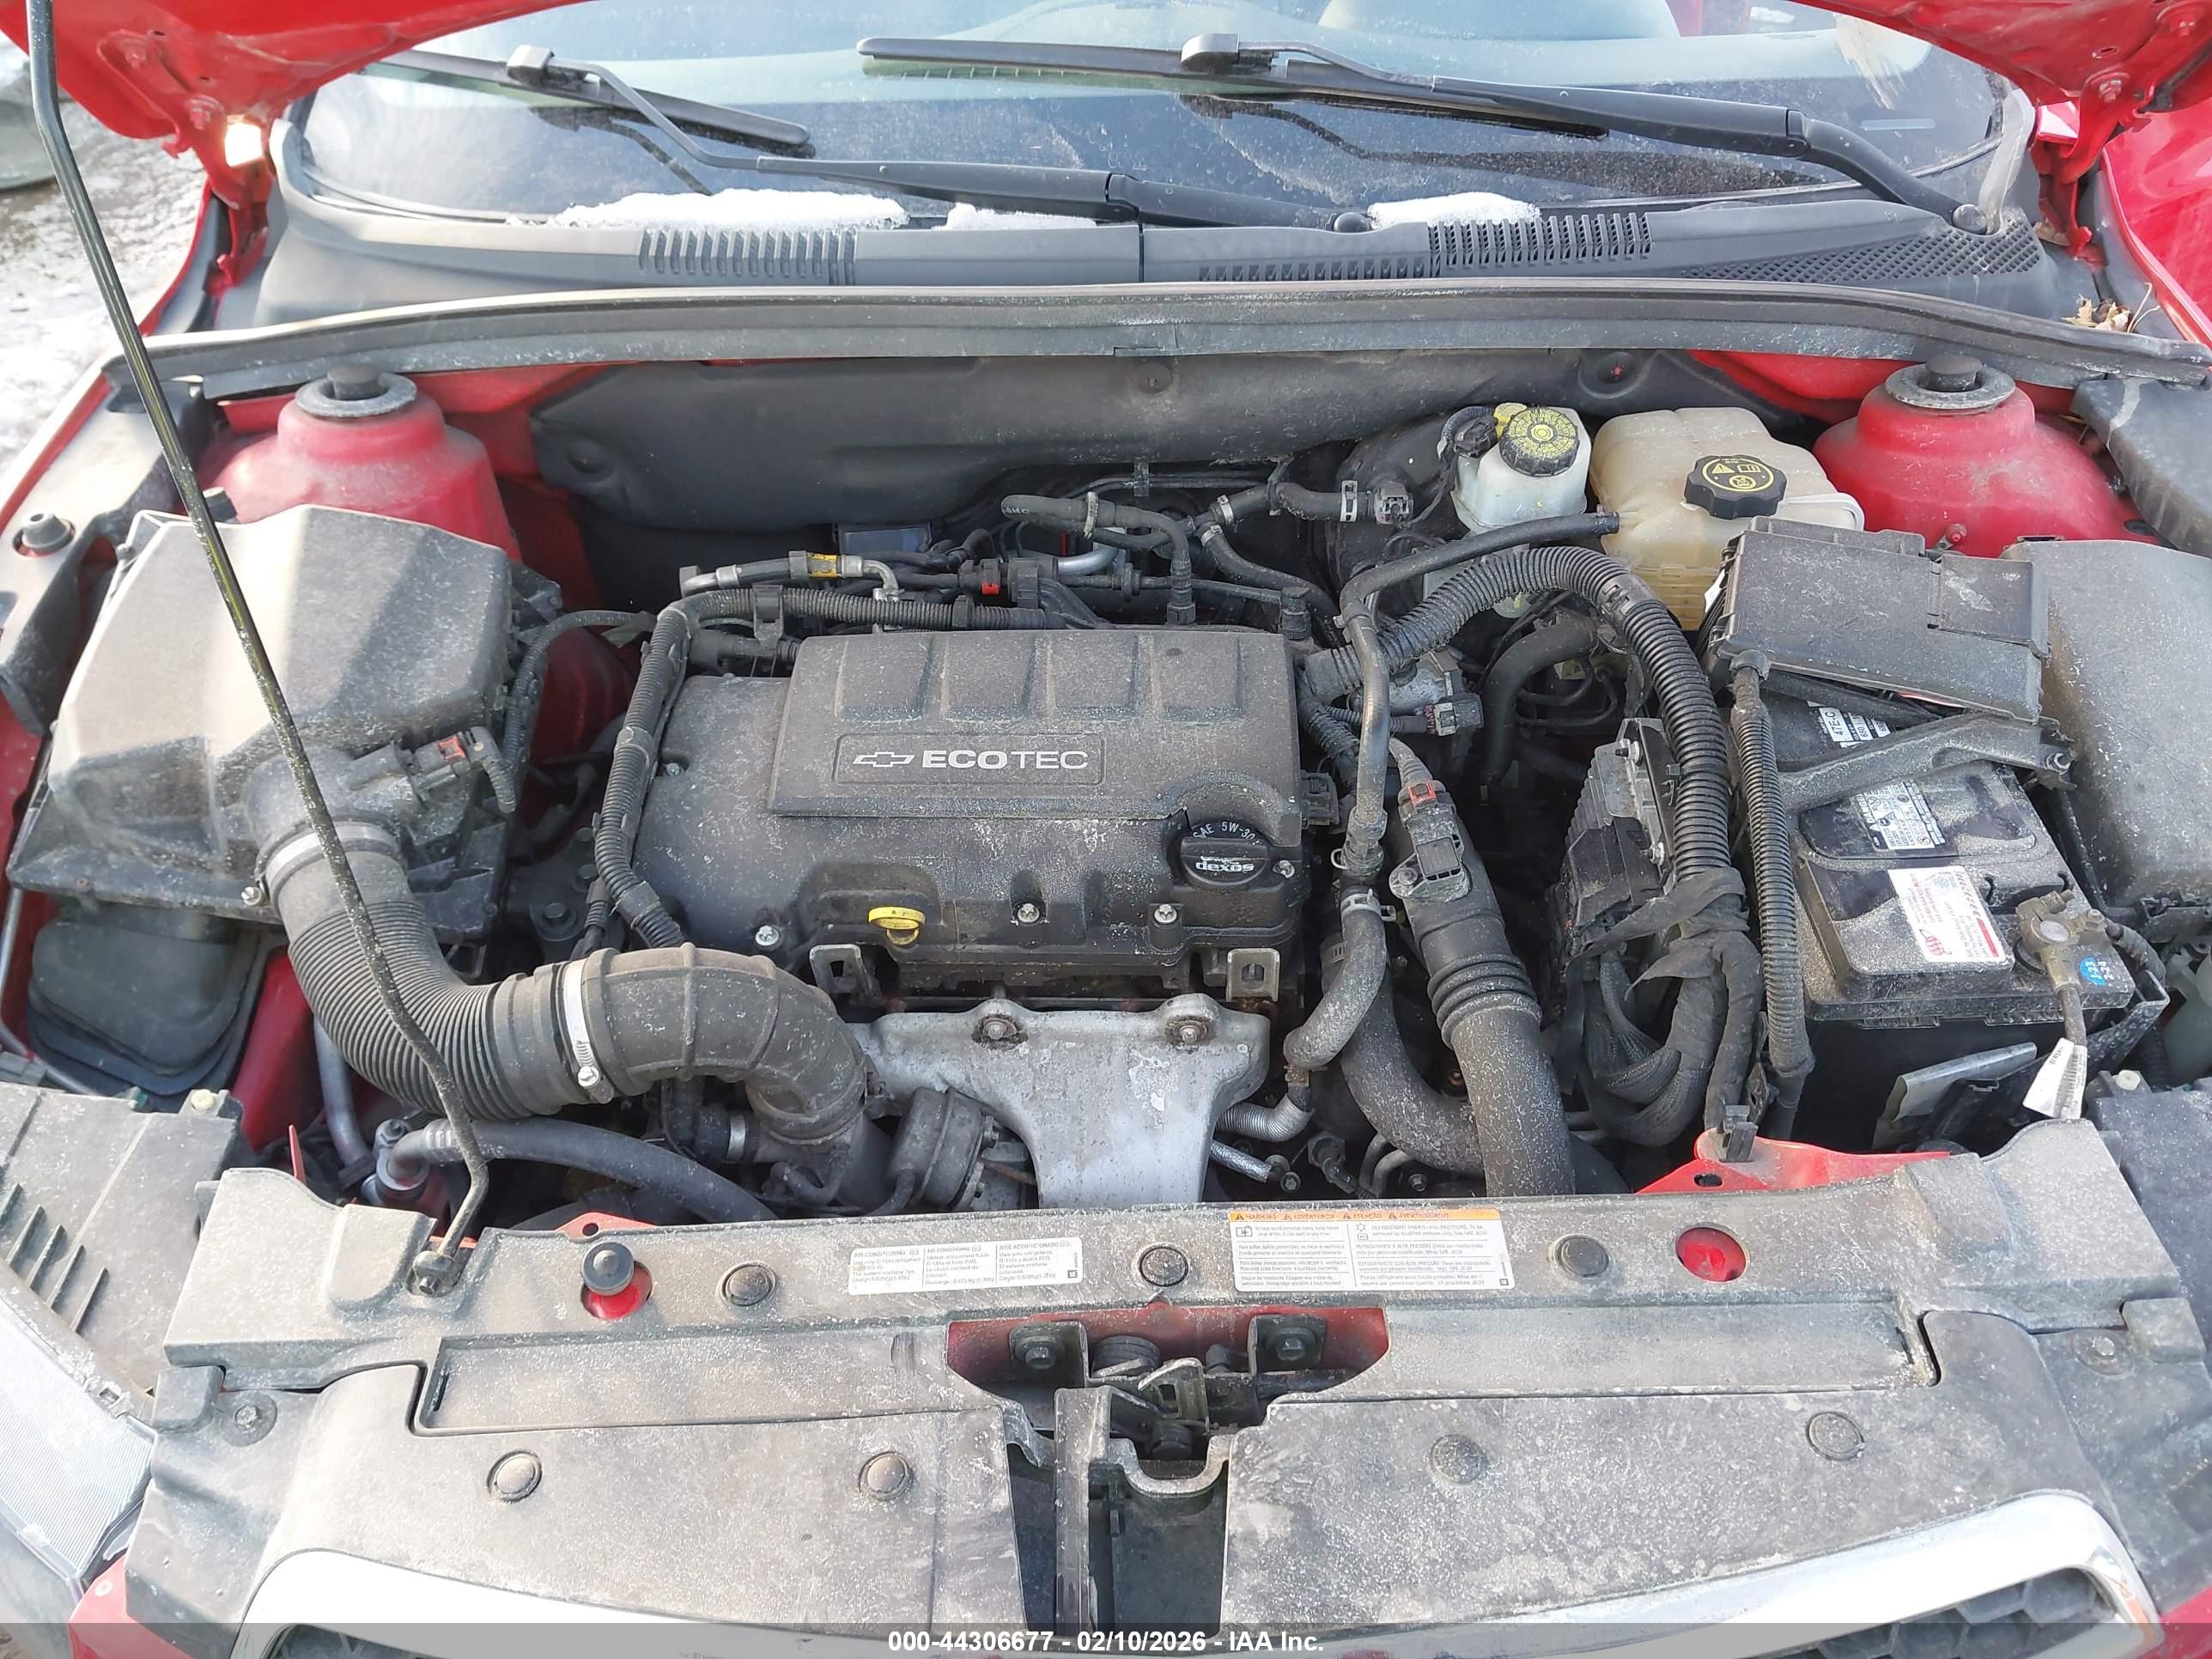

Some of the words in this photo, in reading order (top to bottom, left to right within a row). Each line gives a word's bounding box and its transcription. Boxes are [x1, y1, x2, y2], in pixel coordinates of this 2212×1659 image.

[1825, 711, 1844, 736] 47E-C
[1857, 726, 1869, 738] 650
[922, 750, 1089, 770] ECOTEC
[1856, 793, 1876, 824] DANGE
[1193, 823, 1215, 838] SAE
[1221, 822, 1255, 839] 5W-30
[1195, 860, 1255, 873] dexos
